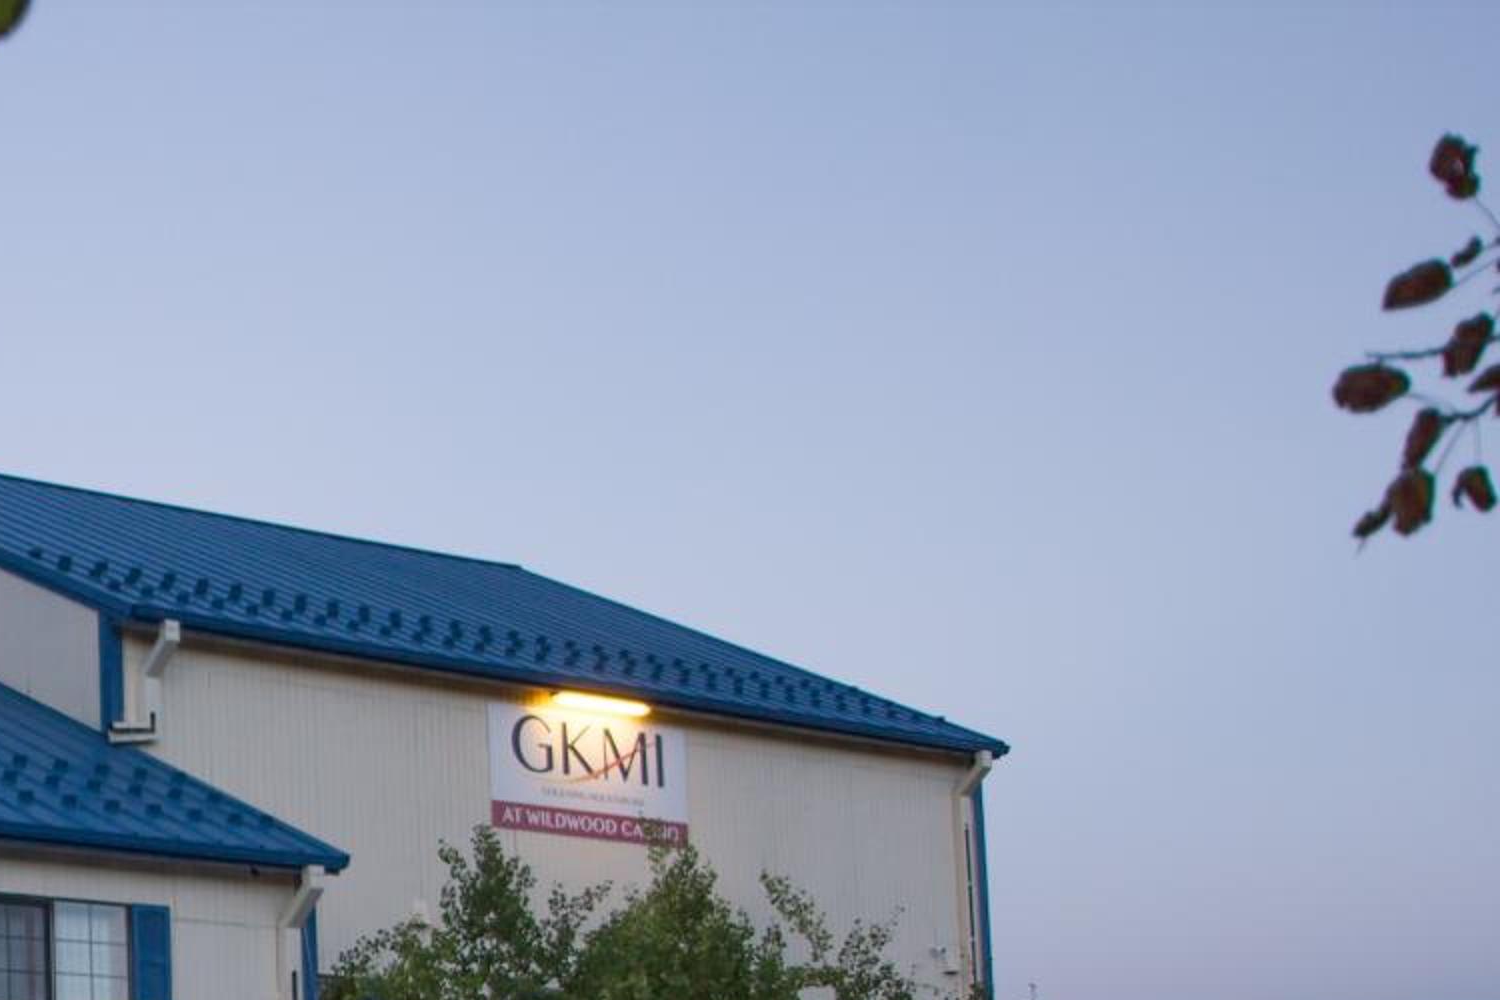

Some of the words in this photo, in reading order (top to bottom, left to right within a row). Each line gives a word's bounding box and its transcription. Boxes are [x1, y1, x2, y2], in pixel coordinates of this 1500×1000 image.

[511, 714, 665, 788] GKMI
[501, 804, 522, 825] AT
[523, 807, 618, 835] WILDWOOD
[621, 820, 679, 842] CANO
